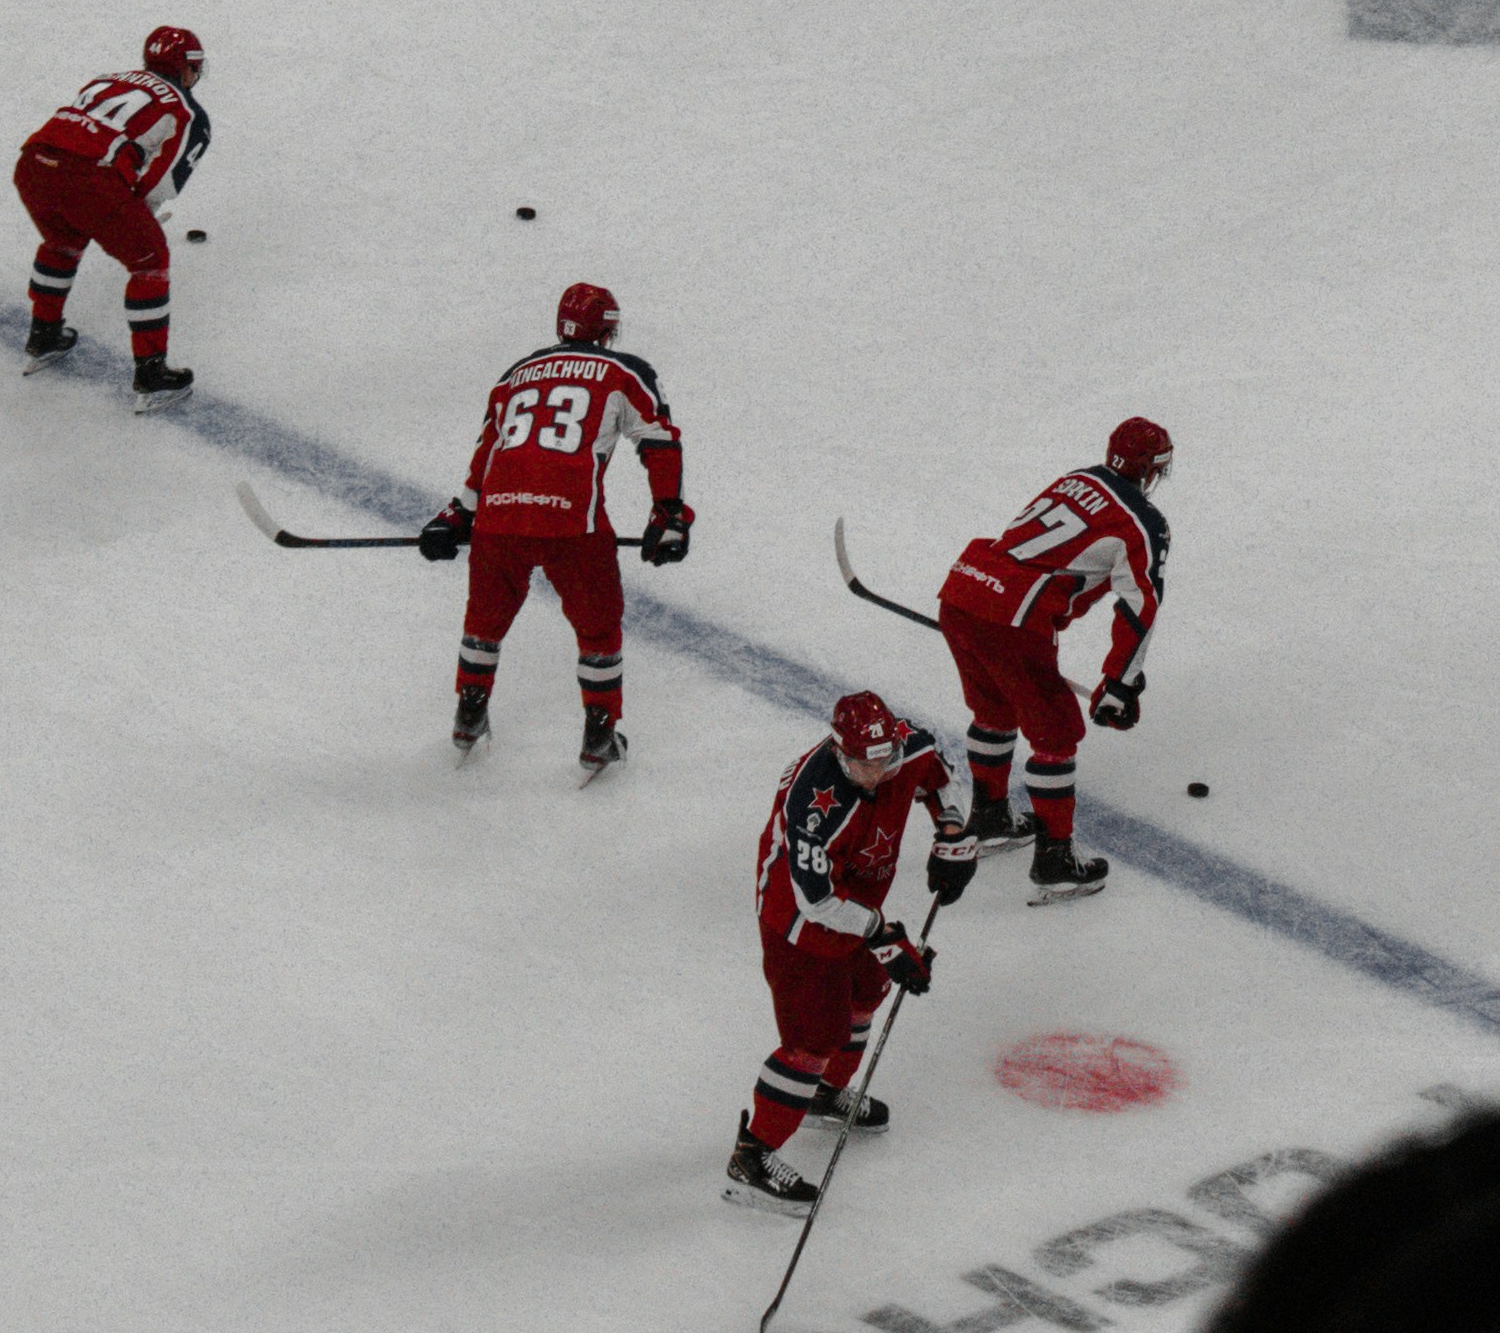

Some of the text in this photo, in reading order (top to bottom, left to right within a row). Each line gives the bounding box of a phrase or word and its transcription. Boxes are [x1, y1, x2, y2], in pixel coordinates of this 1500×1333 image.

[71, 80, 154, 134] 44
[501, 386, 591, 454] 63
[796, 838, 831, 875] 28
